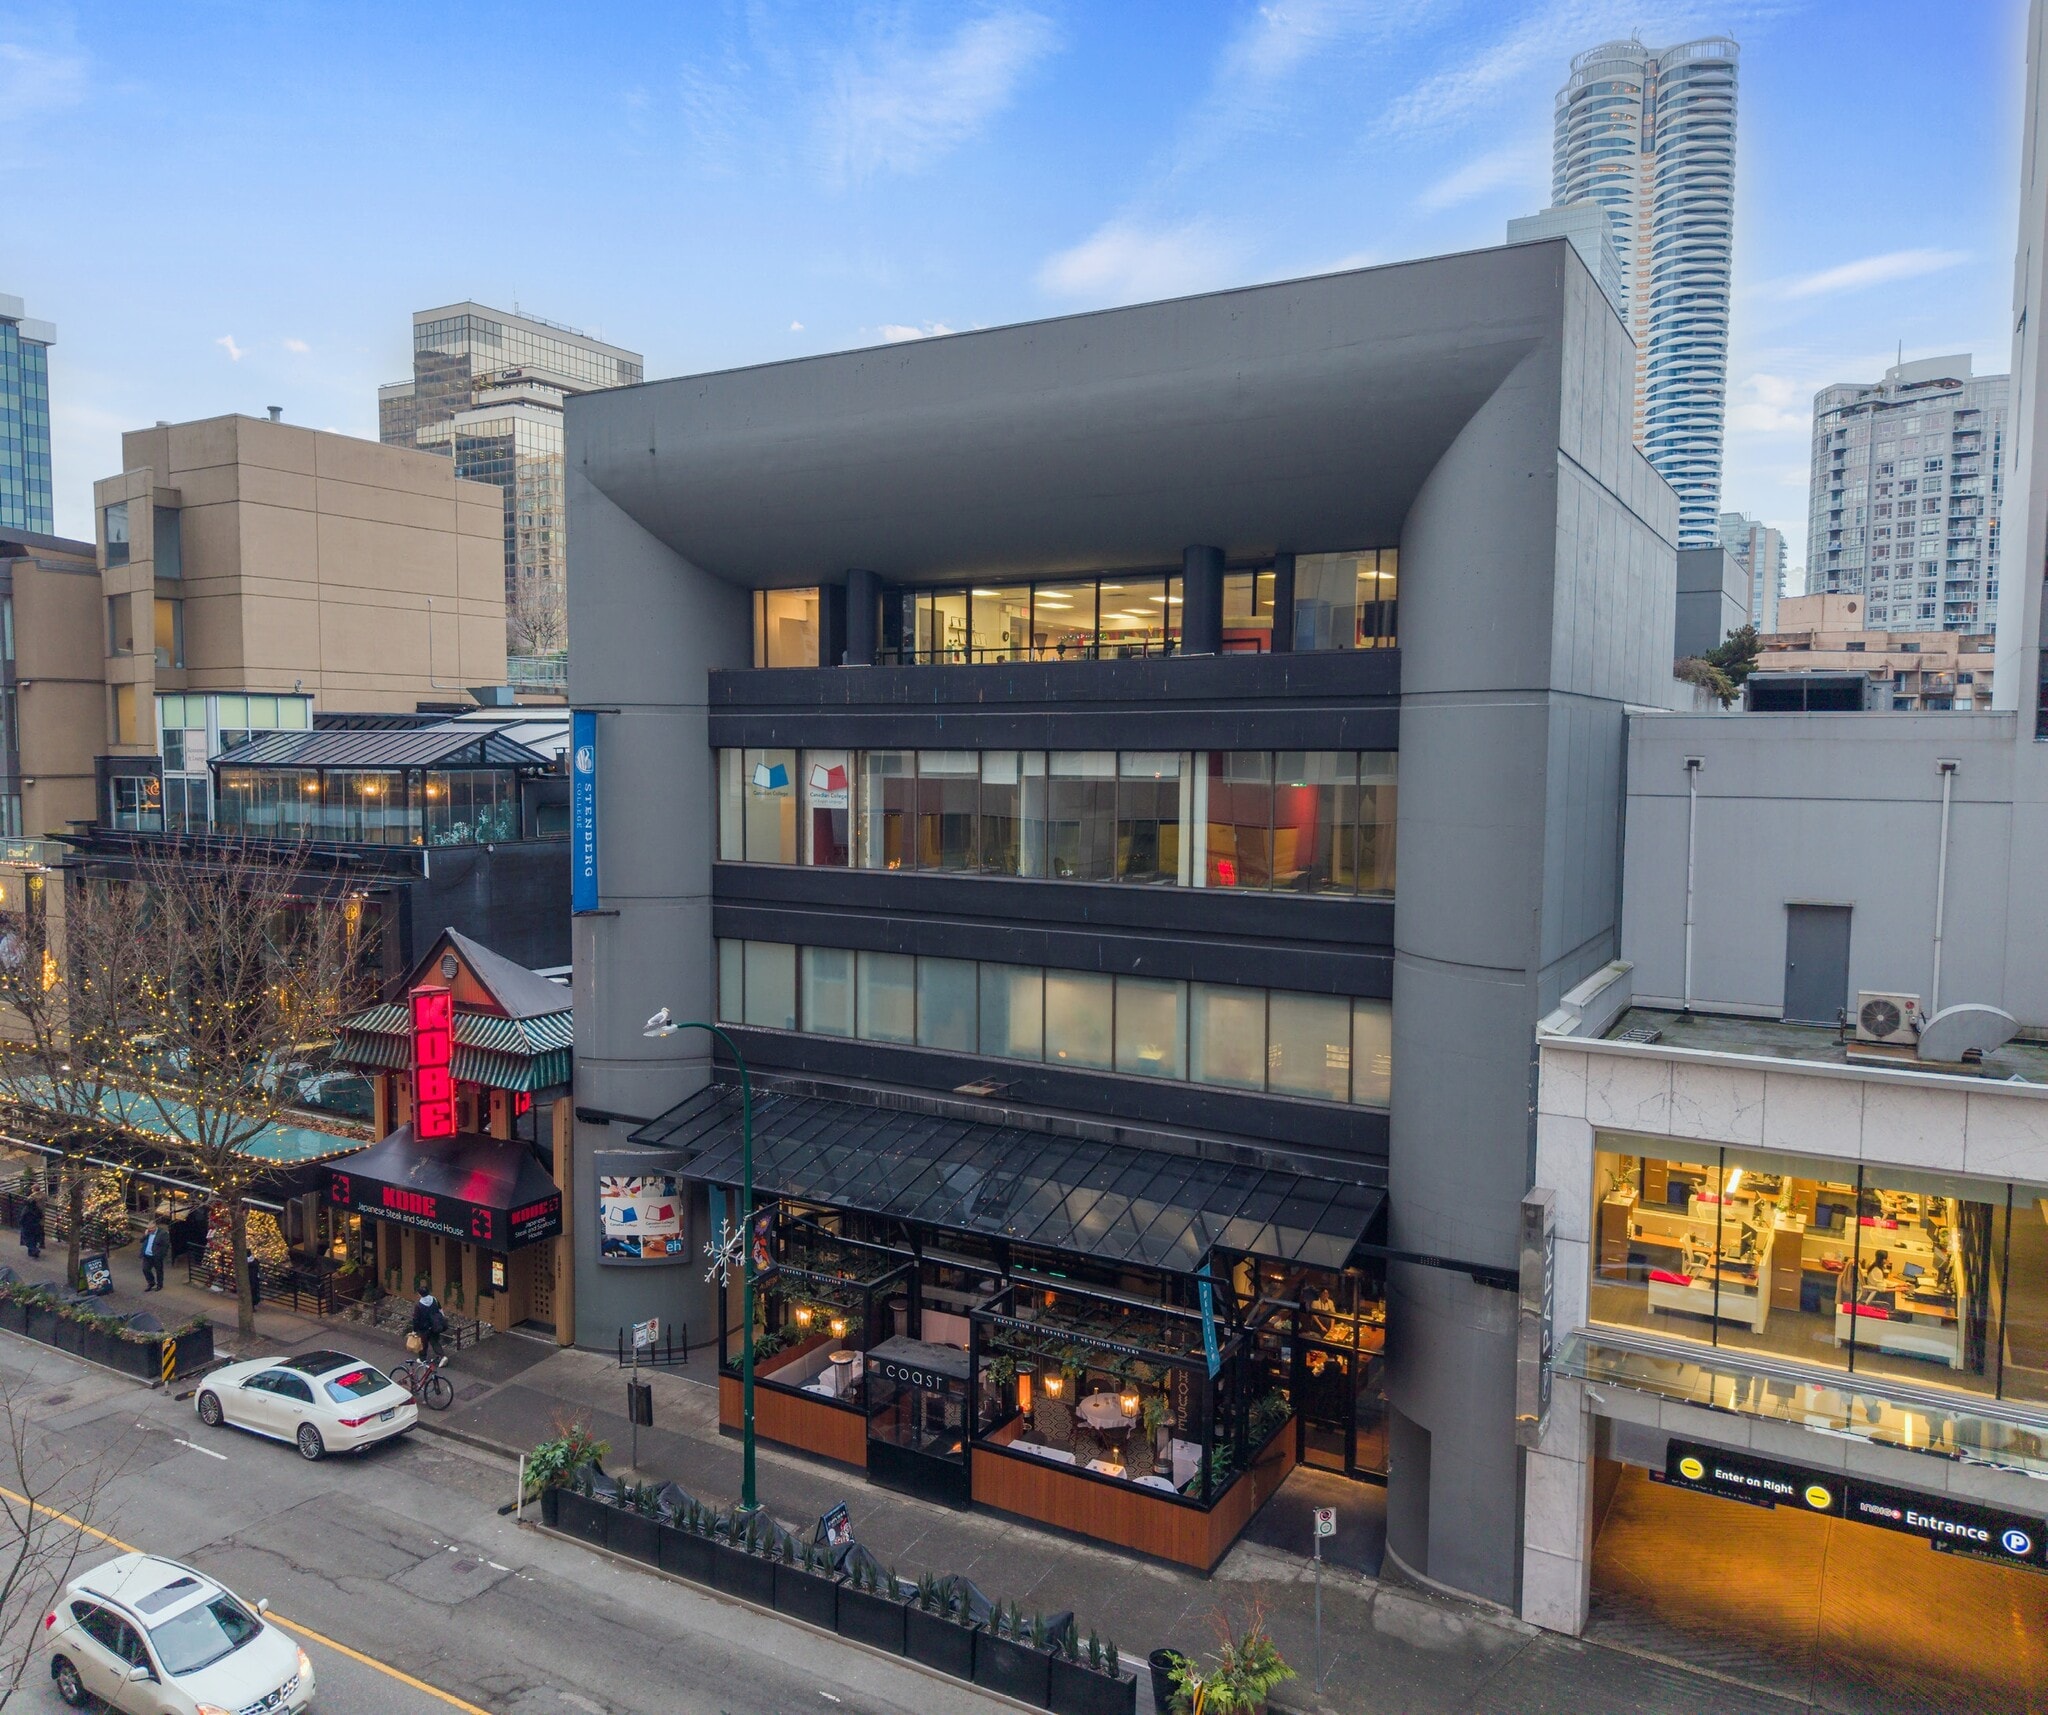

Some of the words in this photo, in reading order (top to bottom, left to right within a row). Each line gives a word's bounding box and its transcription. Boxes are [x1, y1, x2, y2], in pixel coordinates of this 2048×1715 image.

[831, 792, 847, 800] College
[584, 783, 593, 877] STENBERG
[415, 994, 451, 1137] KOBE
[382, 1186, 436, 1217] KOBE
[512, 1201, 548, 1224] KOBE
[358, 1202, 385, 1216] Japanese
[386, 1208, 402, 1220] Steak
[403, 1215, 415, 1223] and
[416, 1216, 443, 1231] Seafood
[443, 1224, 464, 1237] House
[515, 1230, 528, 1238] Steak
[528, 1230, 543, 1239] House
[666, 1240, 682, 1252] eh
[811, 1274, 841, 1285] SHELLFISH
[1543, 1233, 1554, 1358] PARK
[993, 1317, 1013, 1326] FRESH
[1015, 1321, 1030, 1330] FISH
[1041, 1328, 1069, 1339] MUSSELS
[1080, 1337, 1111, 1349] SEAFOOD
[1113, 1344, 1139, 1355] TOWERS
[886, 1365, 942, 1390] coast
[1715, 1469, 1745, 1484] Enter
[1746, 1477, 1760, 1488] on
[1763, 1480, 1794, 1496] Right
[1906, 1511, 1989, 1542] Entrance
[2010, 1534, 2026, 1550] P
